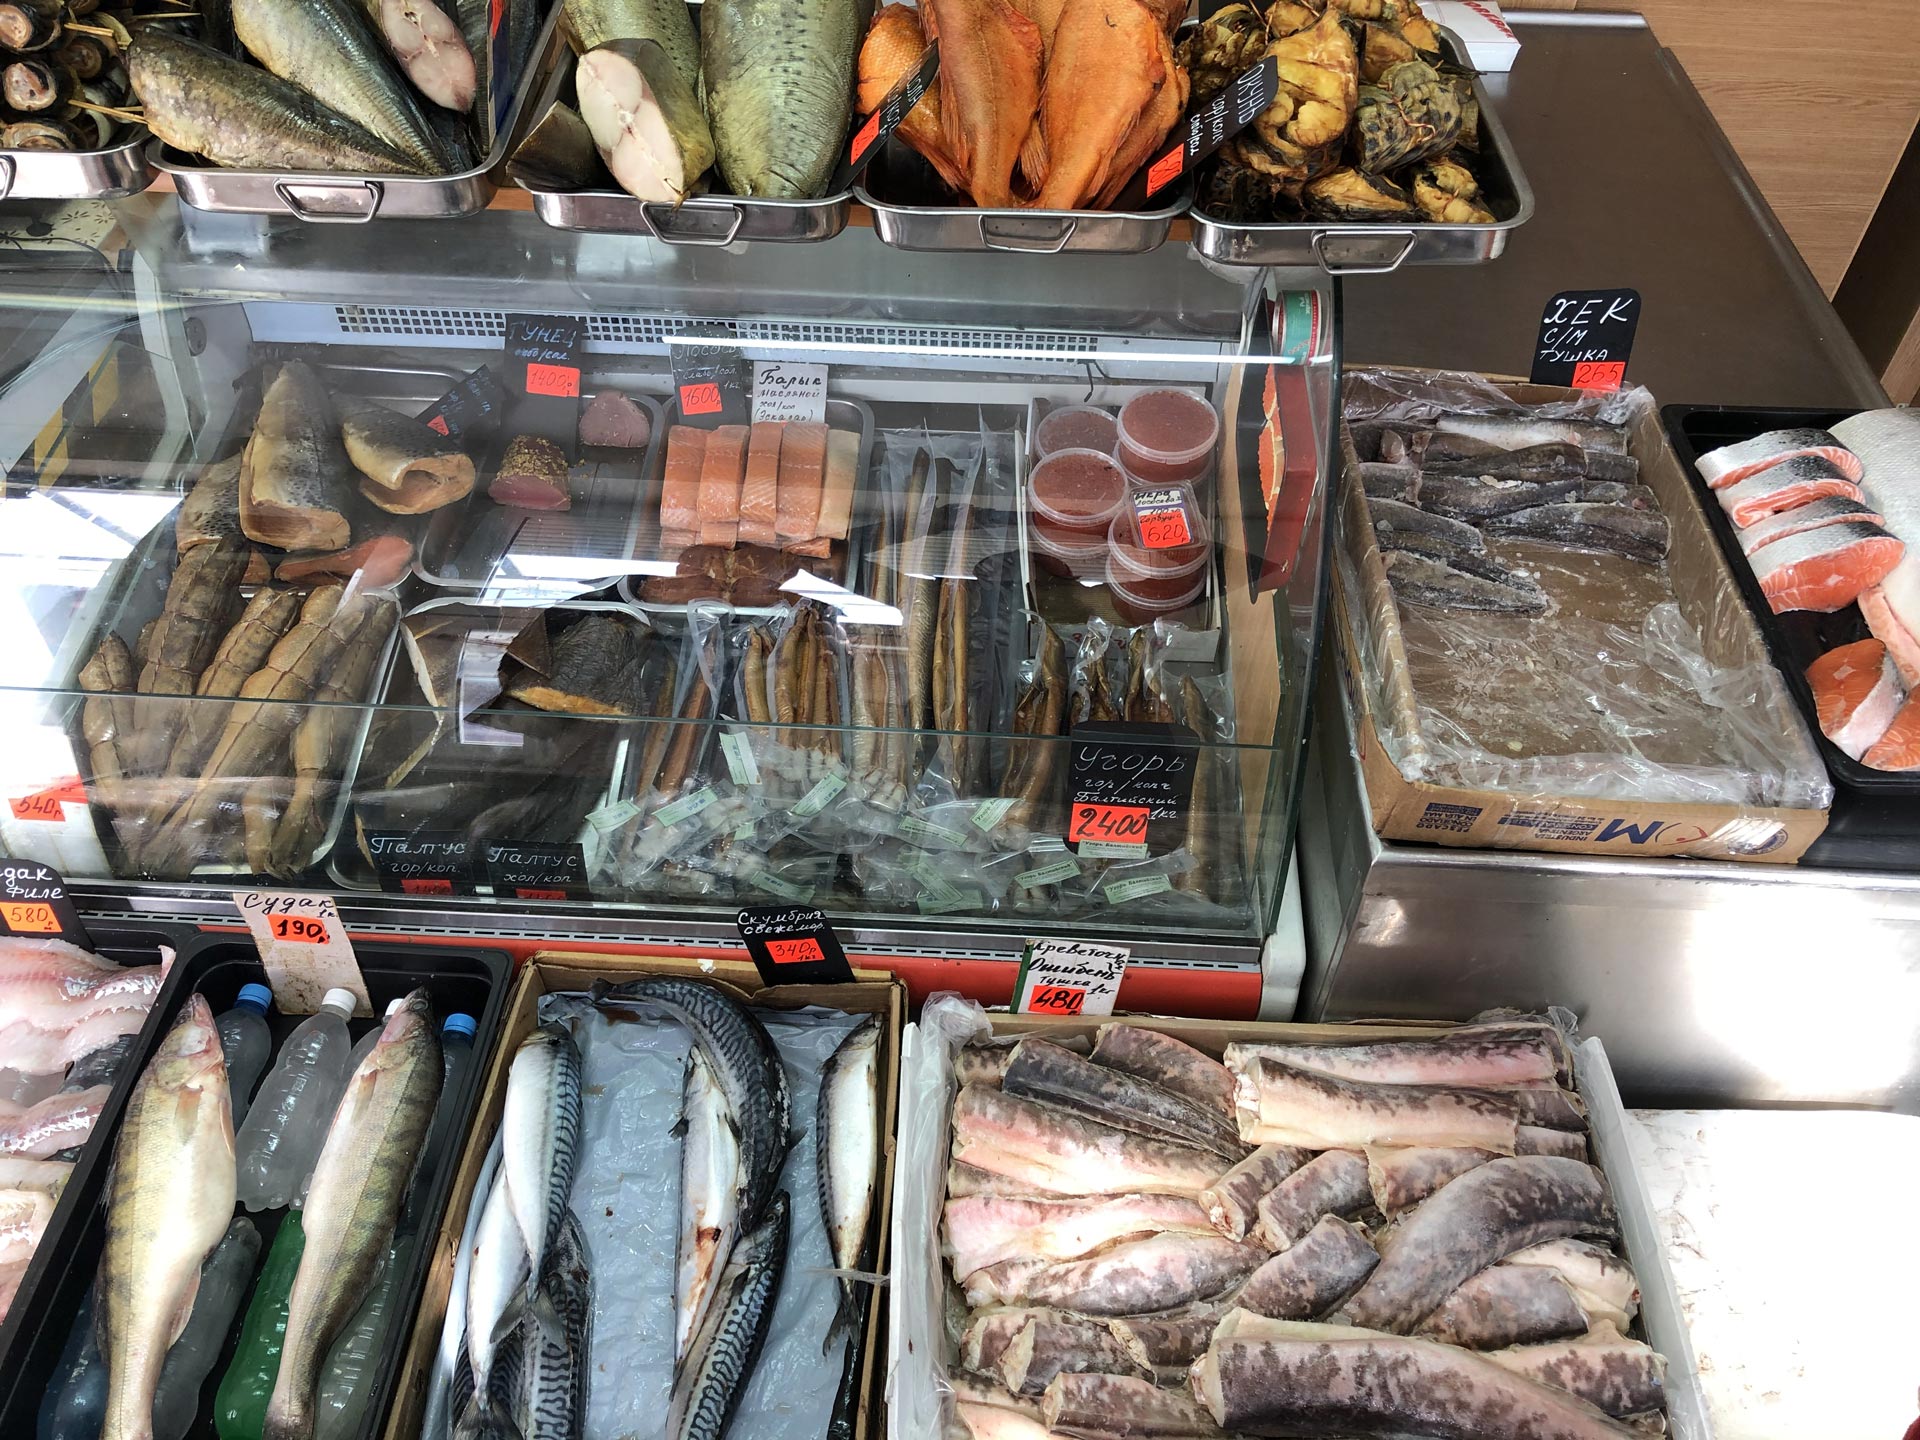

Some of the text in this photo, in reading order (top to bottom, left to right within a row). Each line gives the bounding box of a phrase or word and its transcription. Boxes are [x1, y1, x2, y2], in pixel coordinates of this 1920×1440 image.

[1237, 63, 1265, 124] ОКУНЬ
[1543, 297, 1633, 325] ХЕК
[1576, 364, 1623, 384] 265
[1074, 746, 1186, 780] Угорь
[1075, 807, 1149, 837] 2400
[243, 893, 335, 915] Судак
[737, 910, 826, 925] Скумбрия
